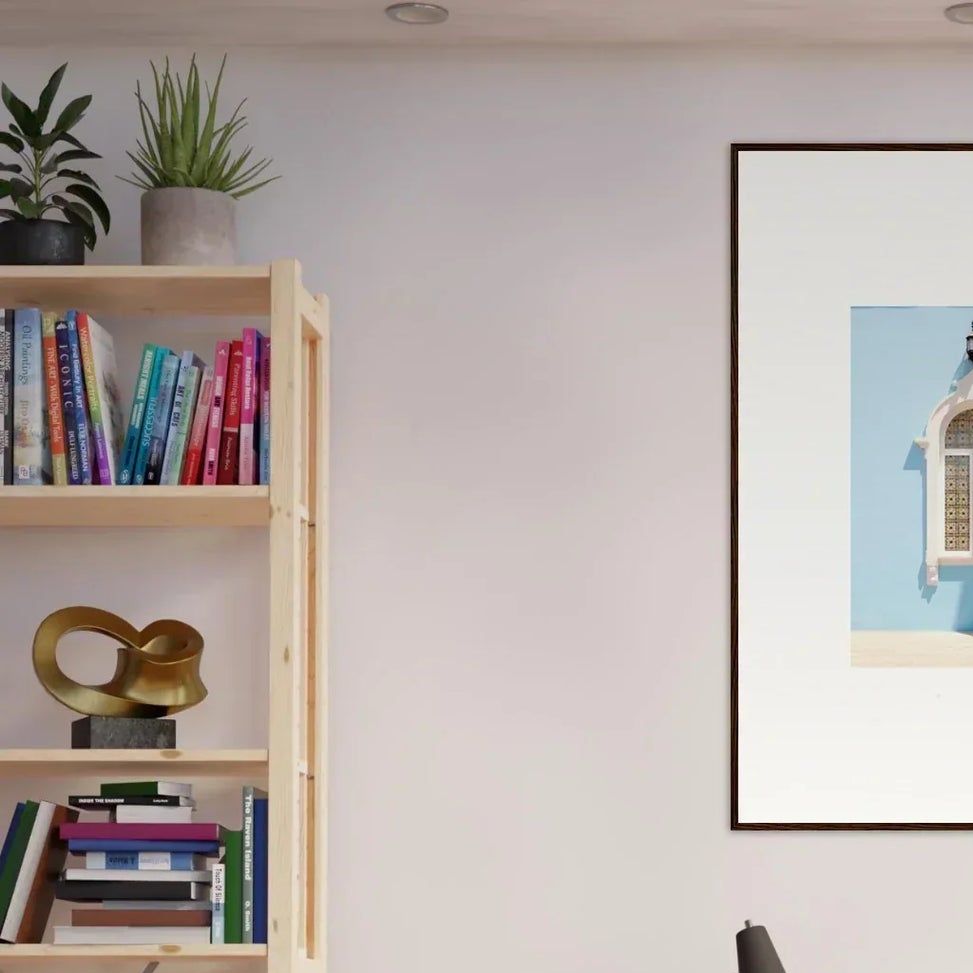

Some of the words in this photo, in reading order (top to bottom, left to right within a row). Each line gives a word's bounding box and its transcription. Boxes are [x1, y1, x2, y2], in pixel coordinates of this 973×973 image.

[21, 325, 32, 340] Oil
[18, 342, 31, 386] Paintings
[47, 347, 55, 364] FINE
[79, 326, 95, 374] Watercolor
[87, 375, 99, 411] Portraits
[230, 363, 240, 396] Parenting
[50, 385, 58, 401] With
[75, 395, 83, 408] ART
[50, 402, 60, 425] Digital
[229, 397, 238, 416] Skills
[142, 396, 157, 446] SUCCESSFUL
[53, 426, 62, 443] Tools
[79, 440, 88, 472] NORMAN
[244, 817, 252, 847] Raven
[244, 850, 252, 881] Island
